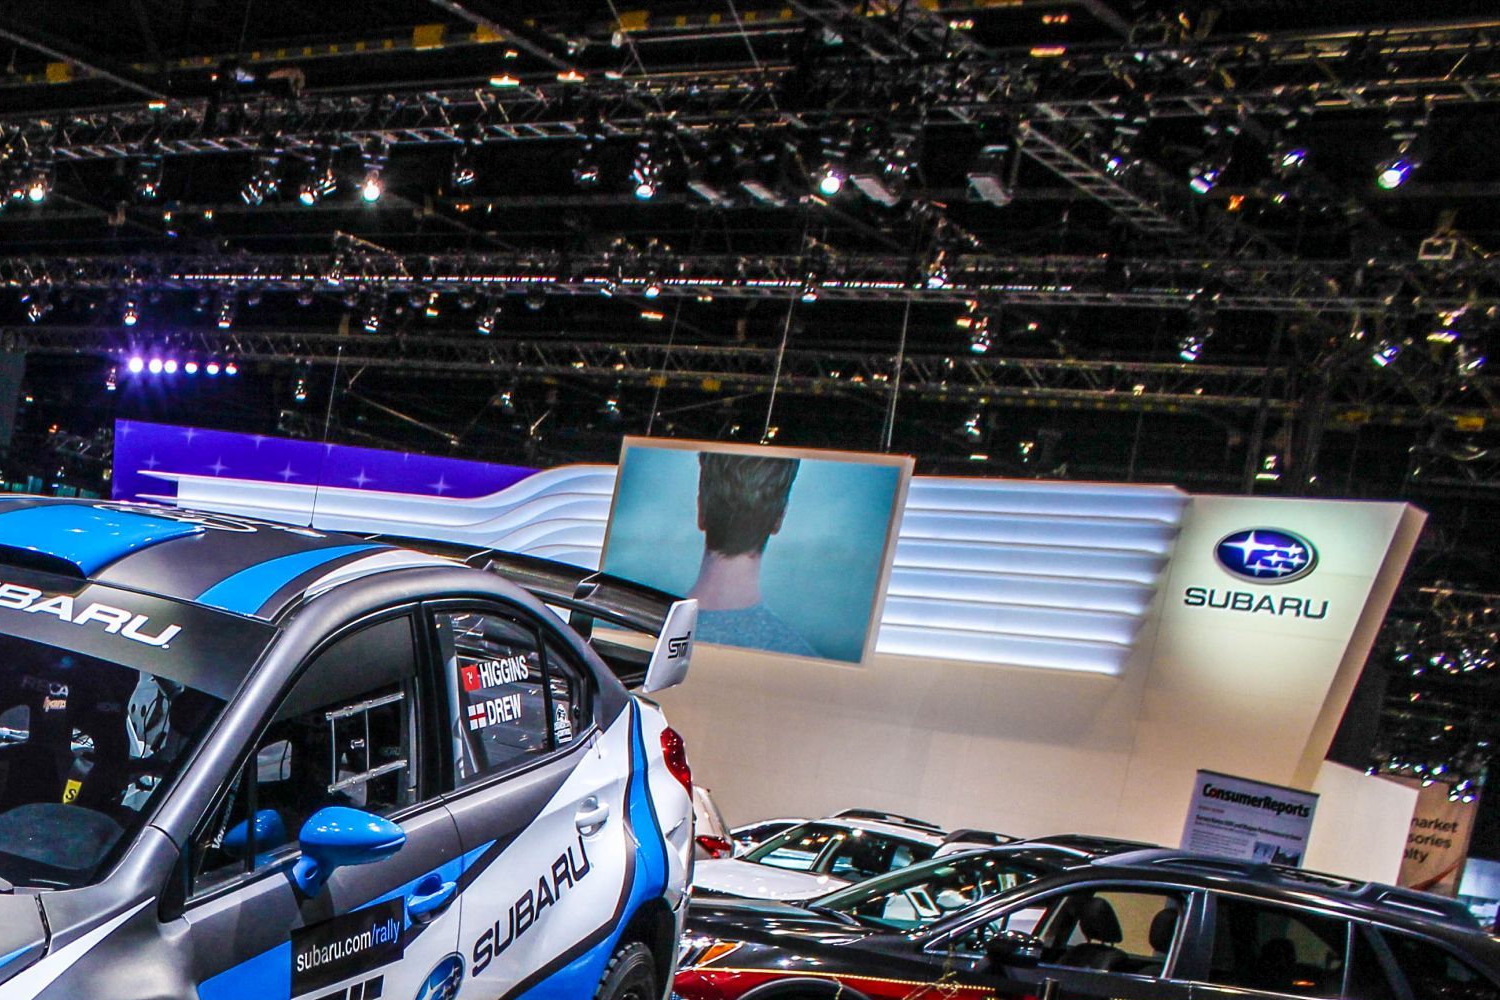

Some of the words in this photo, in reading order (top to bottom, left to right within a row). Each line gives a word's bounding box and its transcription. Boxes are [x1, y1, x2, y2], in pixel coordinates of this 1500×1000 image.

[1183, 586, 1329, 620] SUBARU
[480, 655, 529, 688] HIGGINS
[486, 693, 522, 726] DREW
[1202, 783, 1311, 818] ConsumerReports
[471, 834, 591, 978] SUBARU
[296, 918, 400, 973] subaru.com/rally
